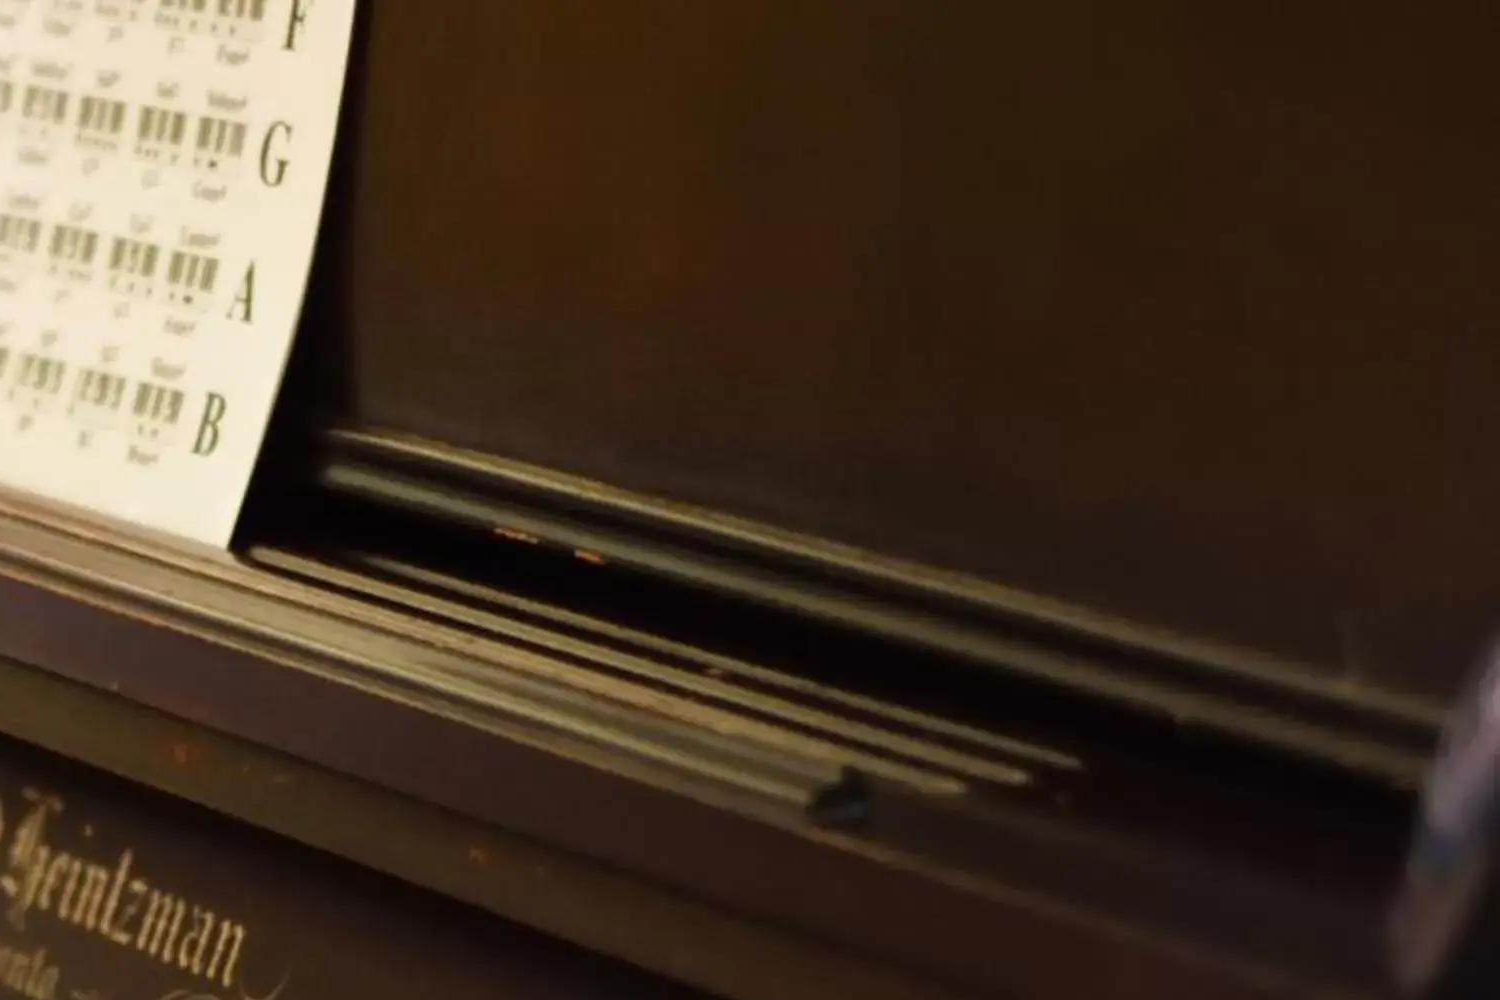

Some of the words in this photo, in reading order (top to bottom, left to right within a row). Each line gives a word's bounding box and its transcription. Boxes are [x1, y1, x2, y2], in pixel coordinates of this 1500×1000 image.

[259, 120, 292, 187] G
[225, 260, 255, 324] A
[190, 391, 227, 458] B
[0, 786, 246, 987] Heintzman
